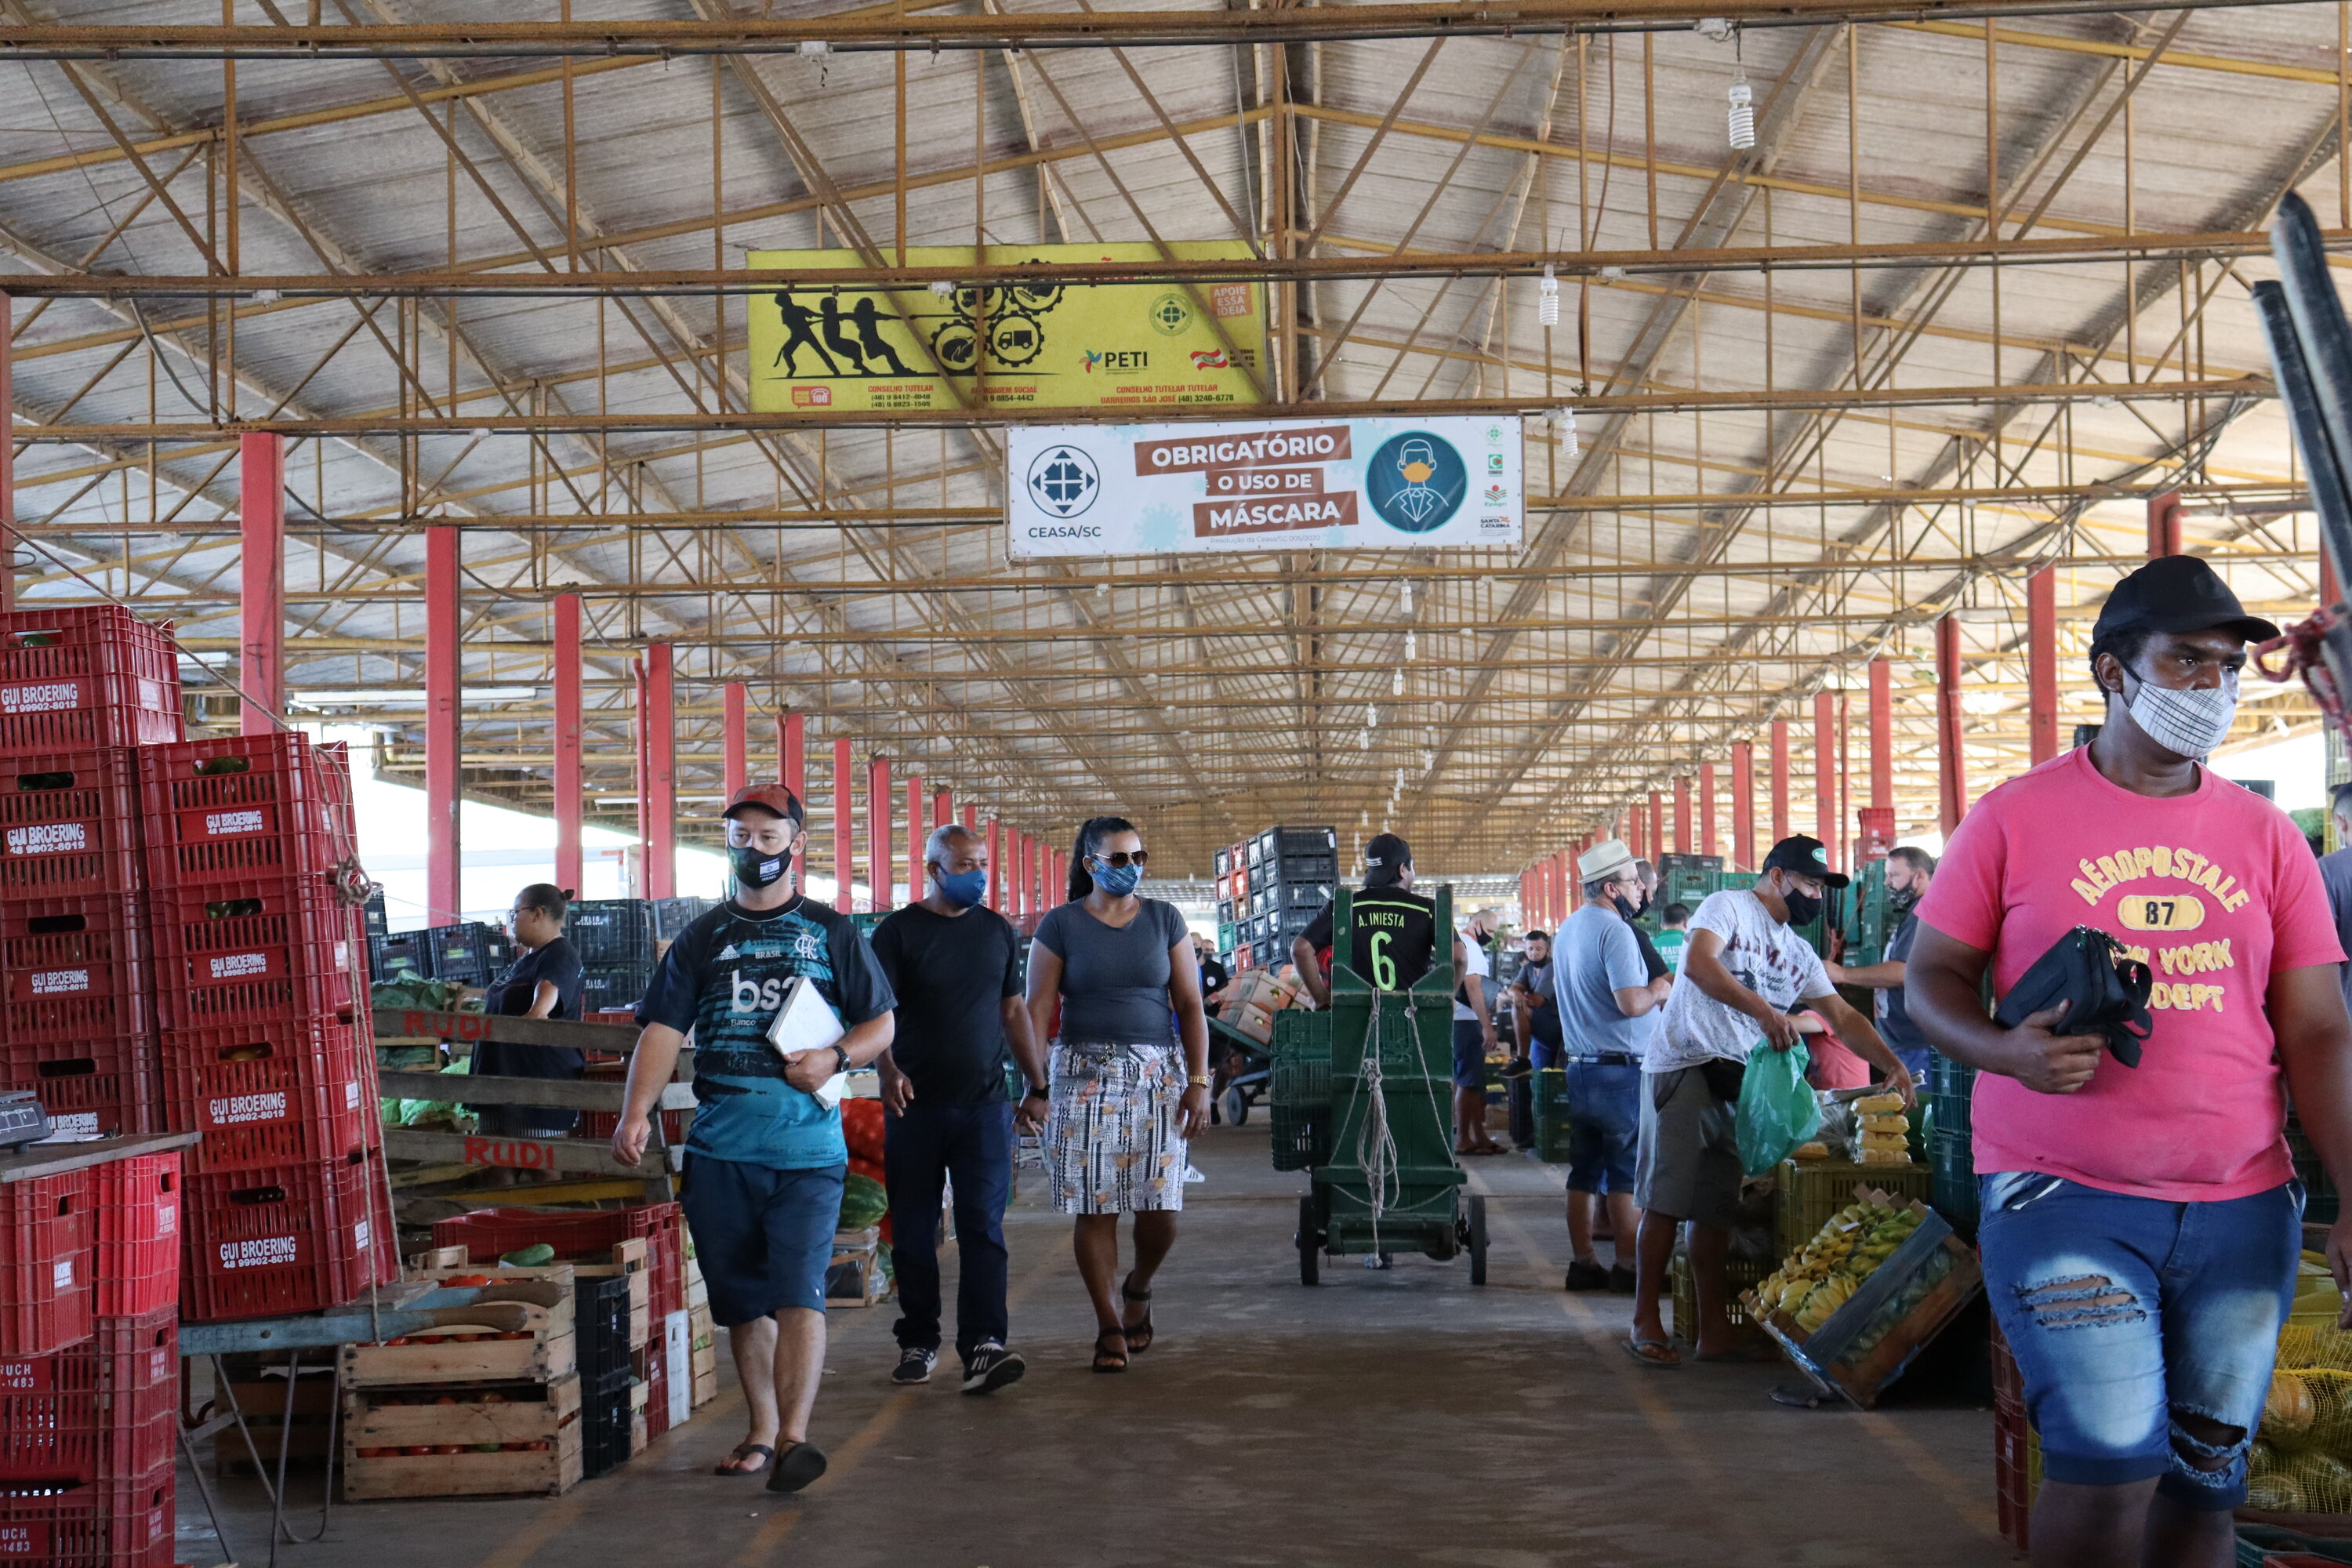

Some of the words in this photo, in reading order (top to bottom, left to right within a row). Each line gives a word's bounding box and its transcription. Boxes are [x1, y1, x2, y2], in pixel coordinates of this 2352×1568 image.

[1214, 285, 1247, 297] APOIE
[1217, 296, 1244, 307] ESSA
[1217, 304, 1247, 316] IDEIA
[1105, 351, 1148, 368] PETI
[1152, 434, 1334, 467] OBRIGATÓRIO
[1218, 476, 1232, 491] O
[1239, 474, 1280, 491] USO
[1285, 474, 1312, 488] DE
[1210, 499, 1341, 529] MÁSCARA
[1029, 526, 1102, 539] CEASA/SC
[1, 688, 20, 706] GUI
[22, 684, 78, 703] BROERING
[206, 815, 221, 829] GUI
[221, 810, 262, 826] BROERING
[7, 827, 27, 847] GUI
[28, 823, 85, 844] BROERING
[2070, 845, 2250, 913] AÉROPOSTALE
[1359, 914, 1367, 928] A.
[1370, 913, 1404, 928] INIESTA
[2146, 902, 2175, 925] 87
[210, 957, 225, 971] GUI
[225, 953, 267, 970] BROERING
[1371, 931, 1396, 991] 6
[2158, 938, 2234, 975] YORK
[32, 973, 46, 987] GUI
[47, 969, 89, 985] BROERING
[2151, 982, 2225, 1012] DEPT
[404, 1011, 492, 1040] RUDI
[209, 1098, 229, 1117] GUI
[230, 1092, 286, 1114] BROERING
[47, 1115, 56, 1130] UI
[56, 1112, 98, 1130] BROERING
[227, 1109, 285, 1123] 99902-8019
[465, 1136, 554, 1170] RUDI
[220, 1243, 239, 1261] GUI
[241, 1236, 296, 1258] BROERING
[223, 1260, 236, 1269] 48
[238, 1254, 296, 1268] 99902-8019
